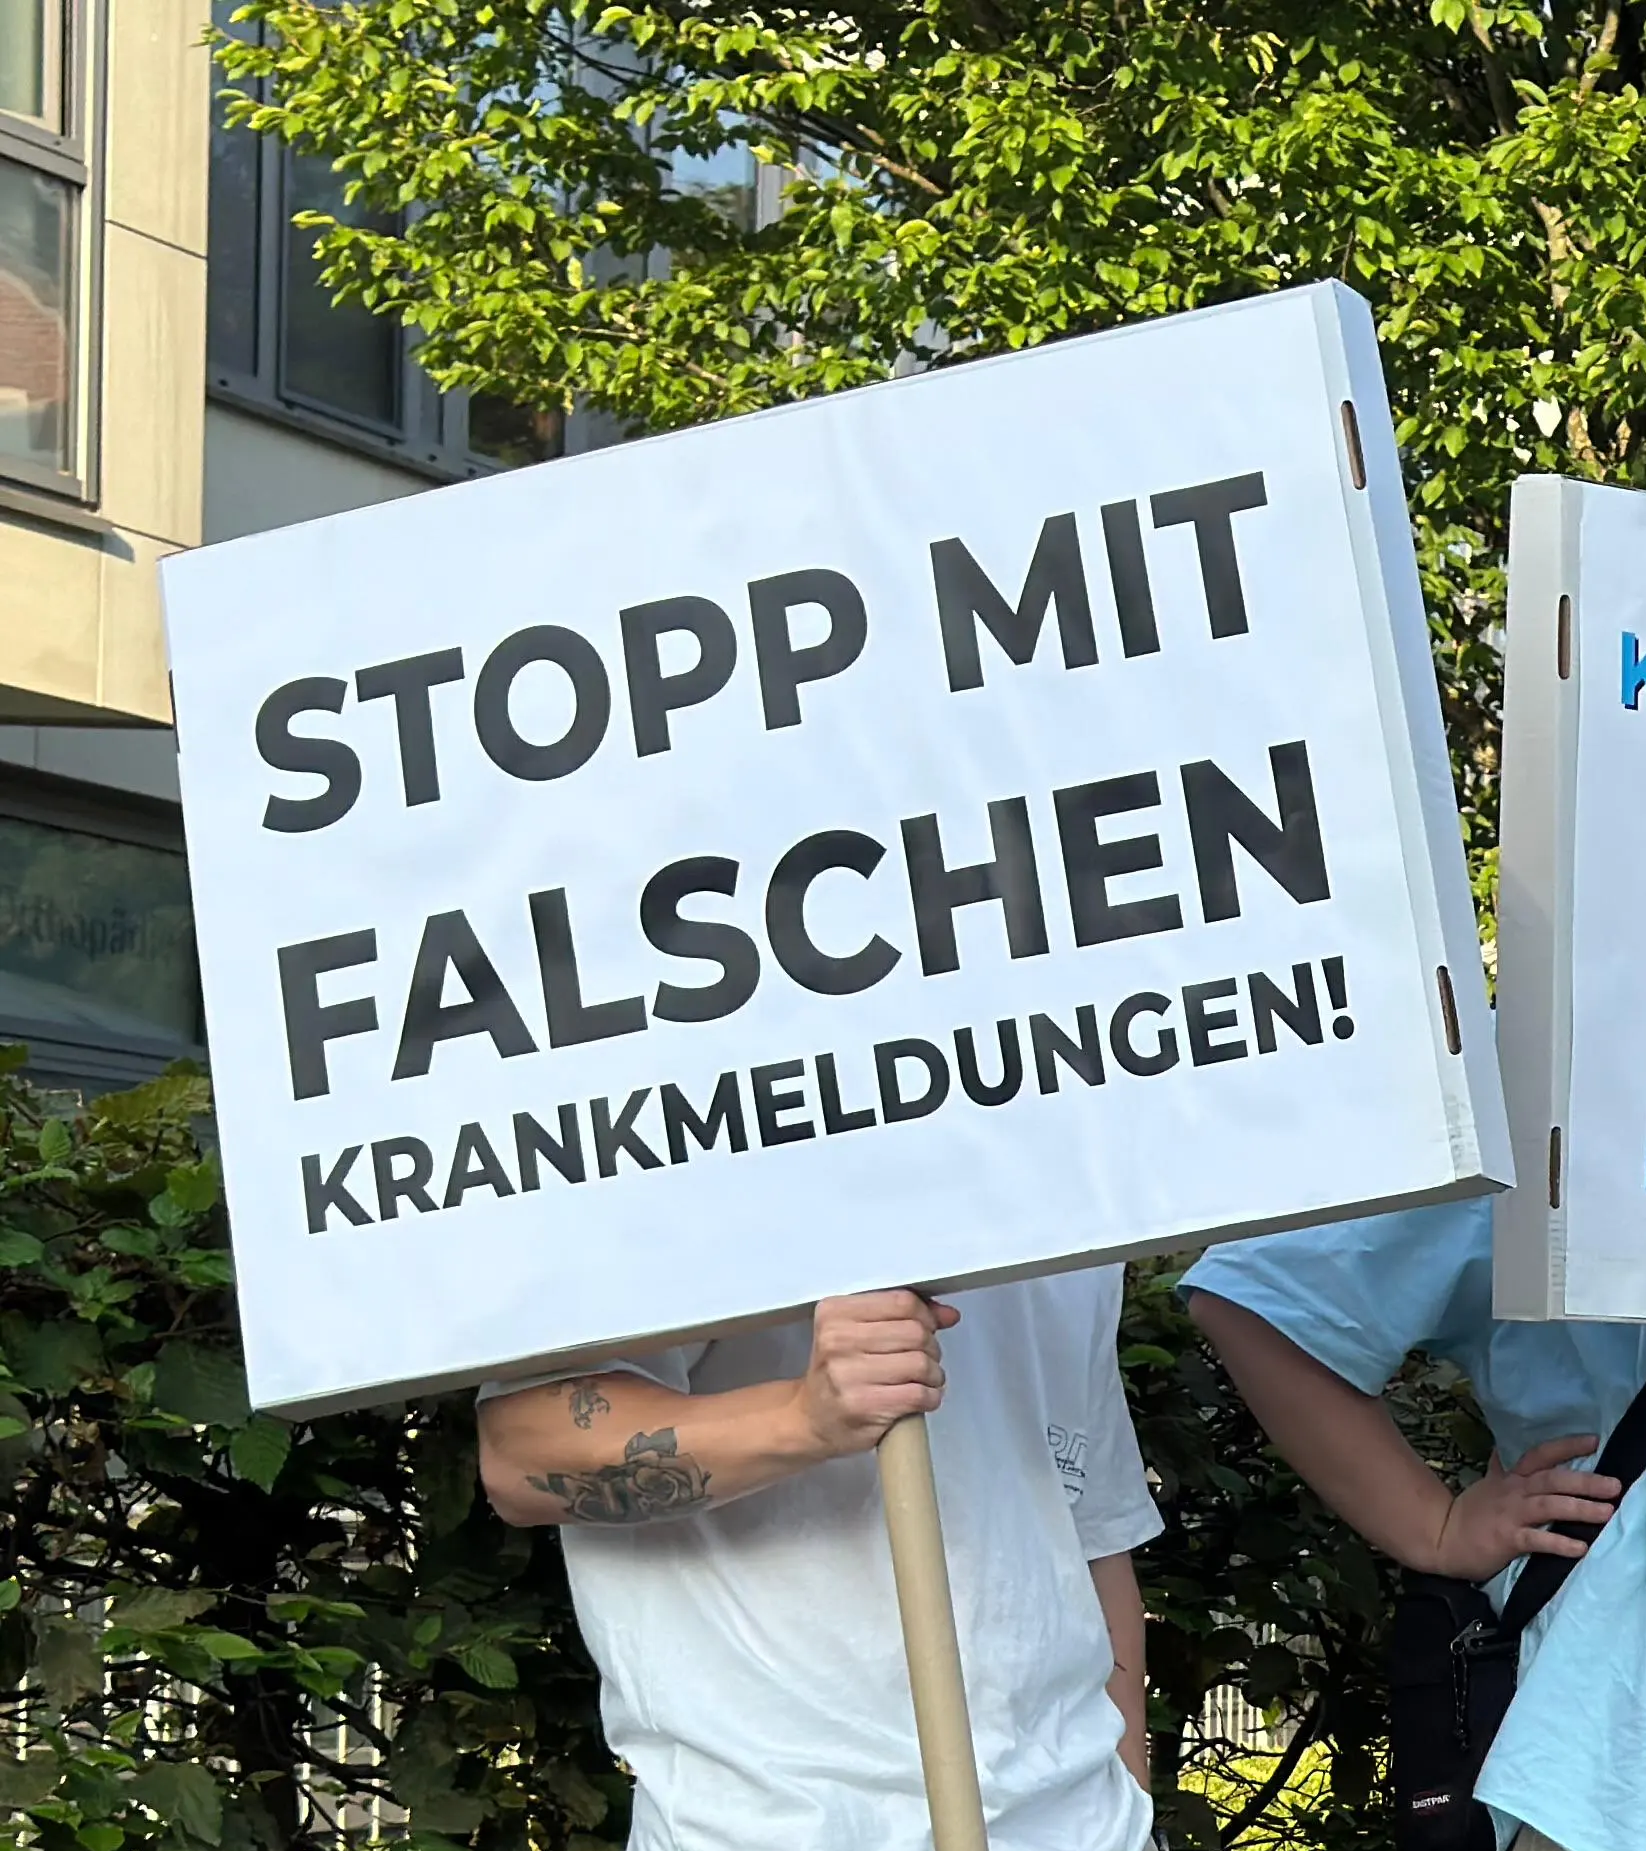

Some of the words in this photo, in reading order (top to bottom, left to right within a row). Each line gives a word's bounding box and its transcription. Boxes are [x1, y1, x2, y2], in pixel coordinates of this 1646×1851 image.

[252, 565, 868, 835] STOPP
[928, 471, 1268, 694] MIT
[275, 738, 1332, 1102] FALSCHEN
[298, 955, 1357, 1235] KRANKMELDUNGEN!
